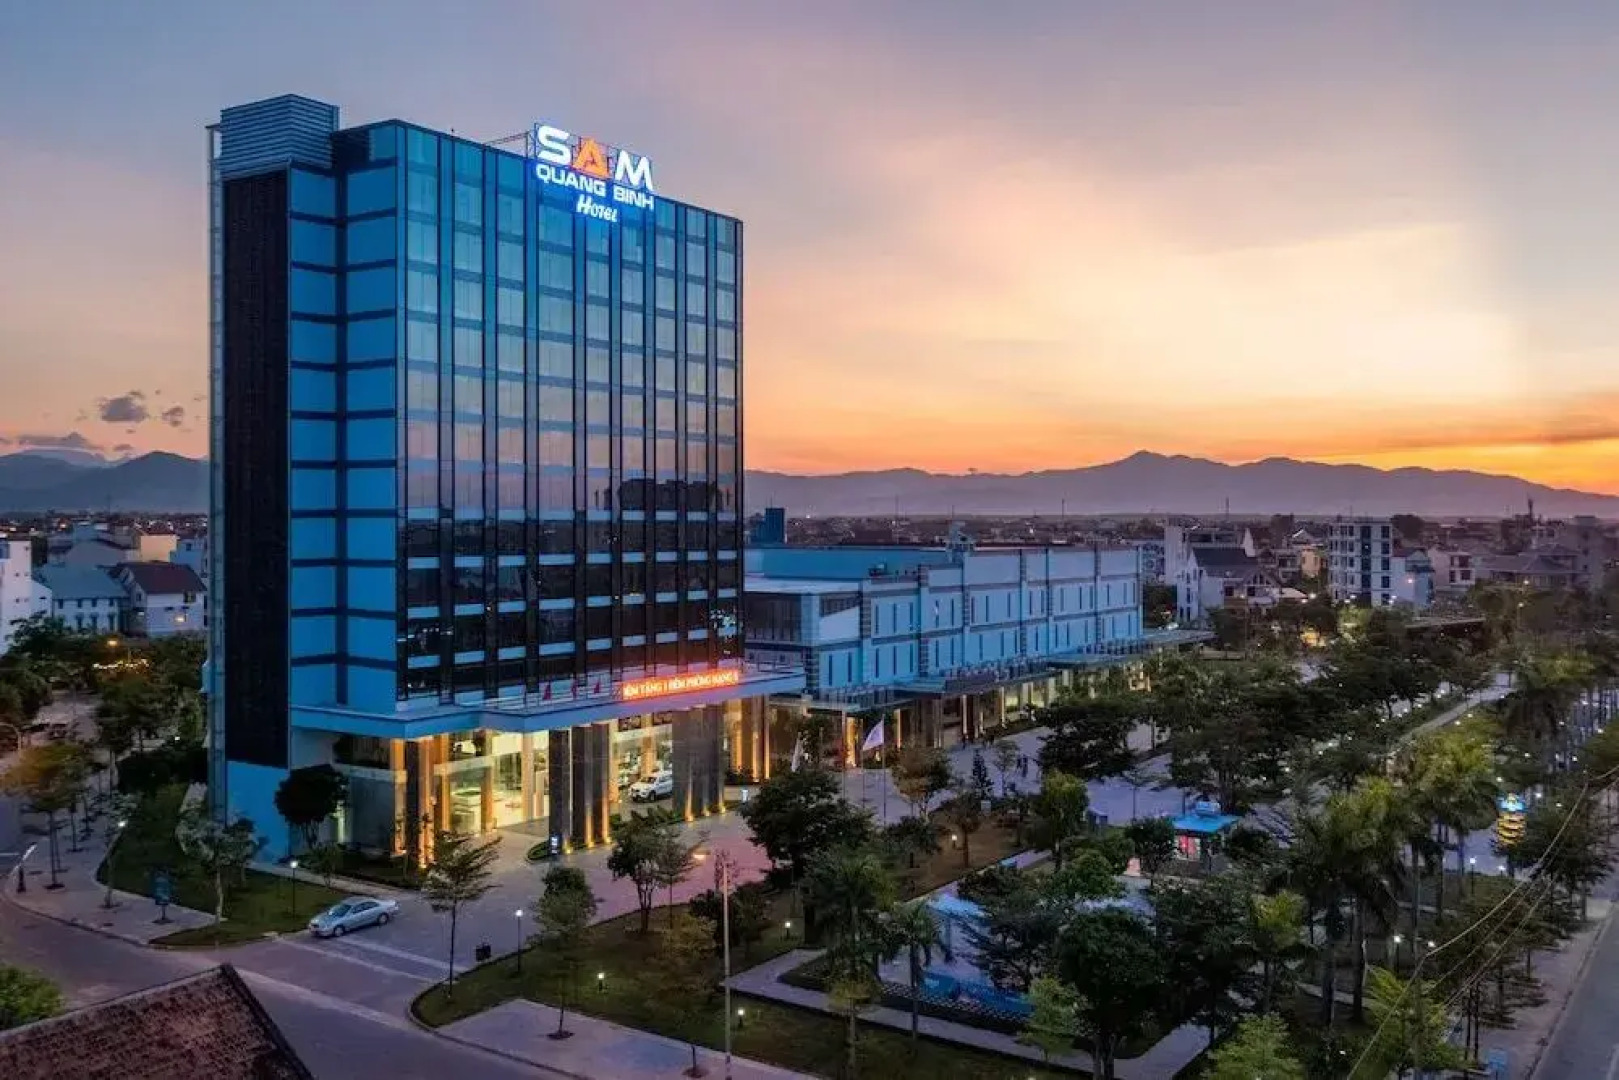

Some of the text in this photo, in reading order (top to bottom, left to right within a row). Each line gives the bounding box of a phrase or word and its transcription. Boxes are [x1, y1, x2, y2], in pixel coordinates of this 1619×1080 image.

[538, 126, 653, 191] SAM
[536, 164, 654, 211] QUANG BINH
